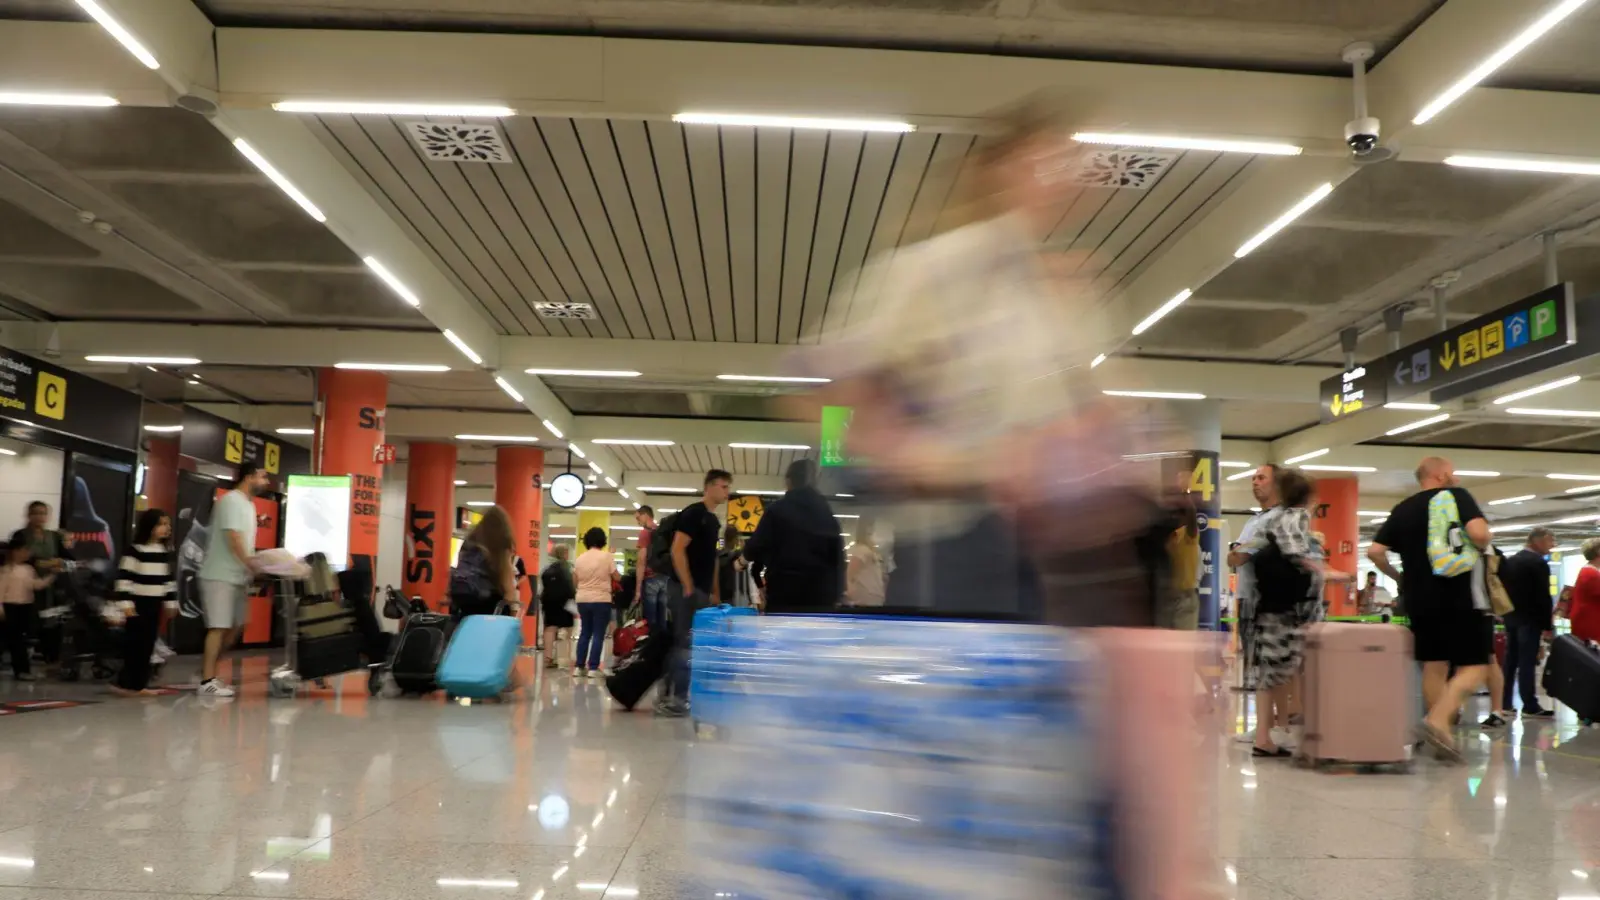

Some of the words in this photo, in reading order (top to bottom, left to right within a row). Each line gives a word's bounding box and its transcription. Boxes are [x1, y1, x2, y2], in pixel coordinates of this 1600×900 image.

[44, 382, 58, 409] C
[355, 474, 376, 489] THE
[1190, 457, 1215, 501] 4
[407, 503, 435, 584] SIXT
